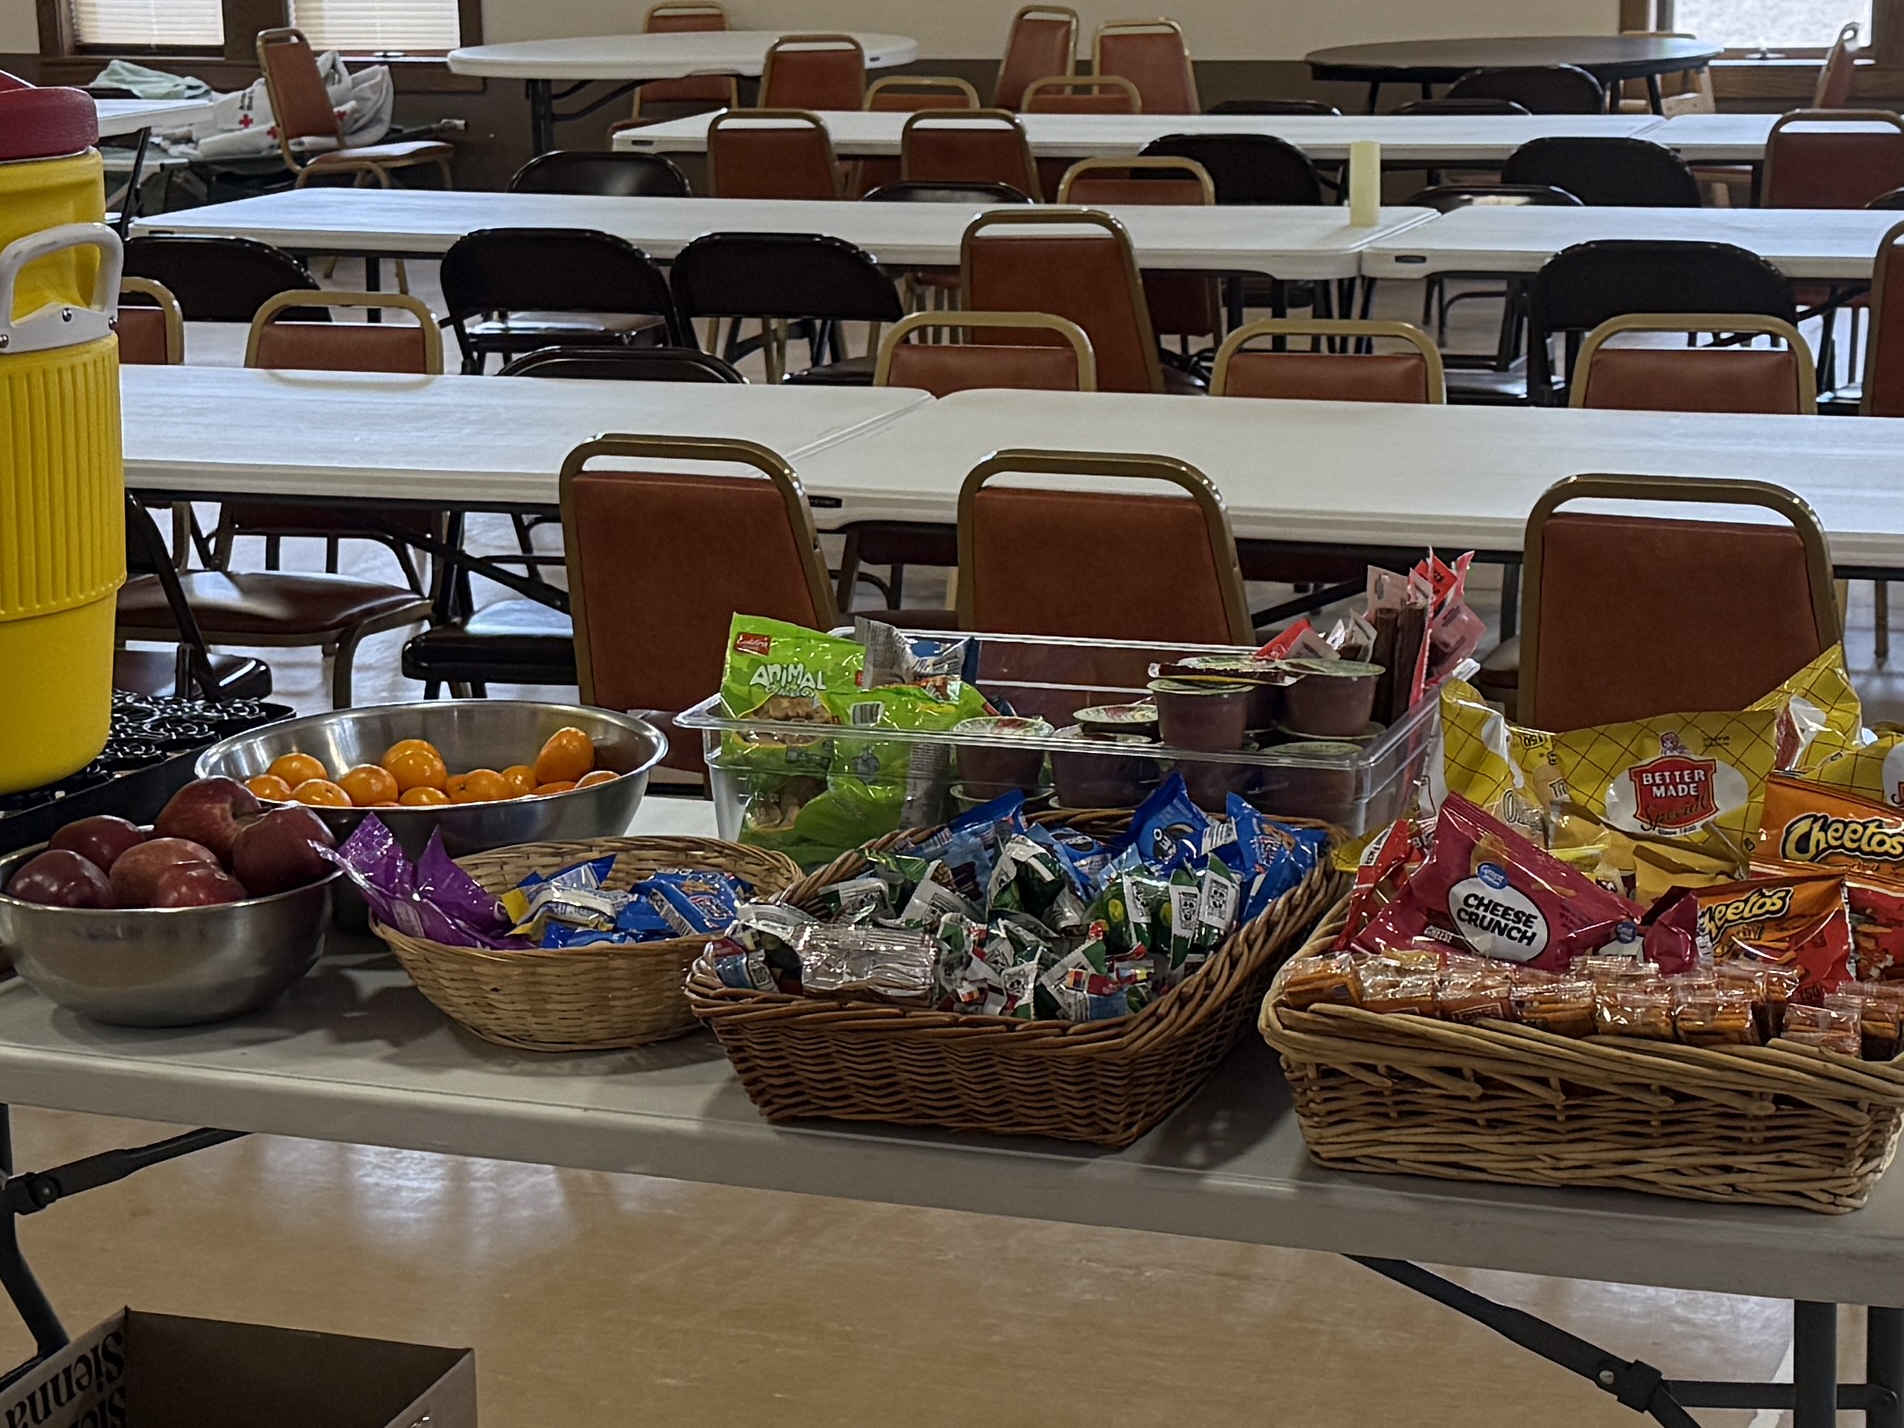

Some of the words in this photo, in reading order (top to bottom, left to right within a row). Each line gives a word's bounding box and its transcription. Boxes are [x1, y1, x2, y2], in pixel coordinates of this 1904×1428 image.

[749, 662, 827, 691] ANIMAL
[1642, 768, 1706, 786] BETTER
[1652, 782, 1699, 799] MADE
[1462, 892, 1538, 930] CHEESE
[1456, 905, 1537, 947] CRUNCH
